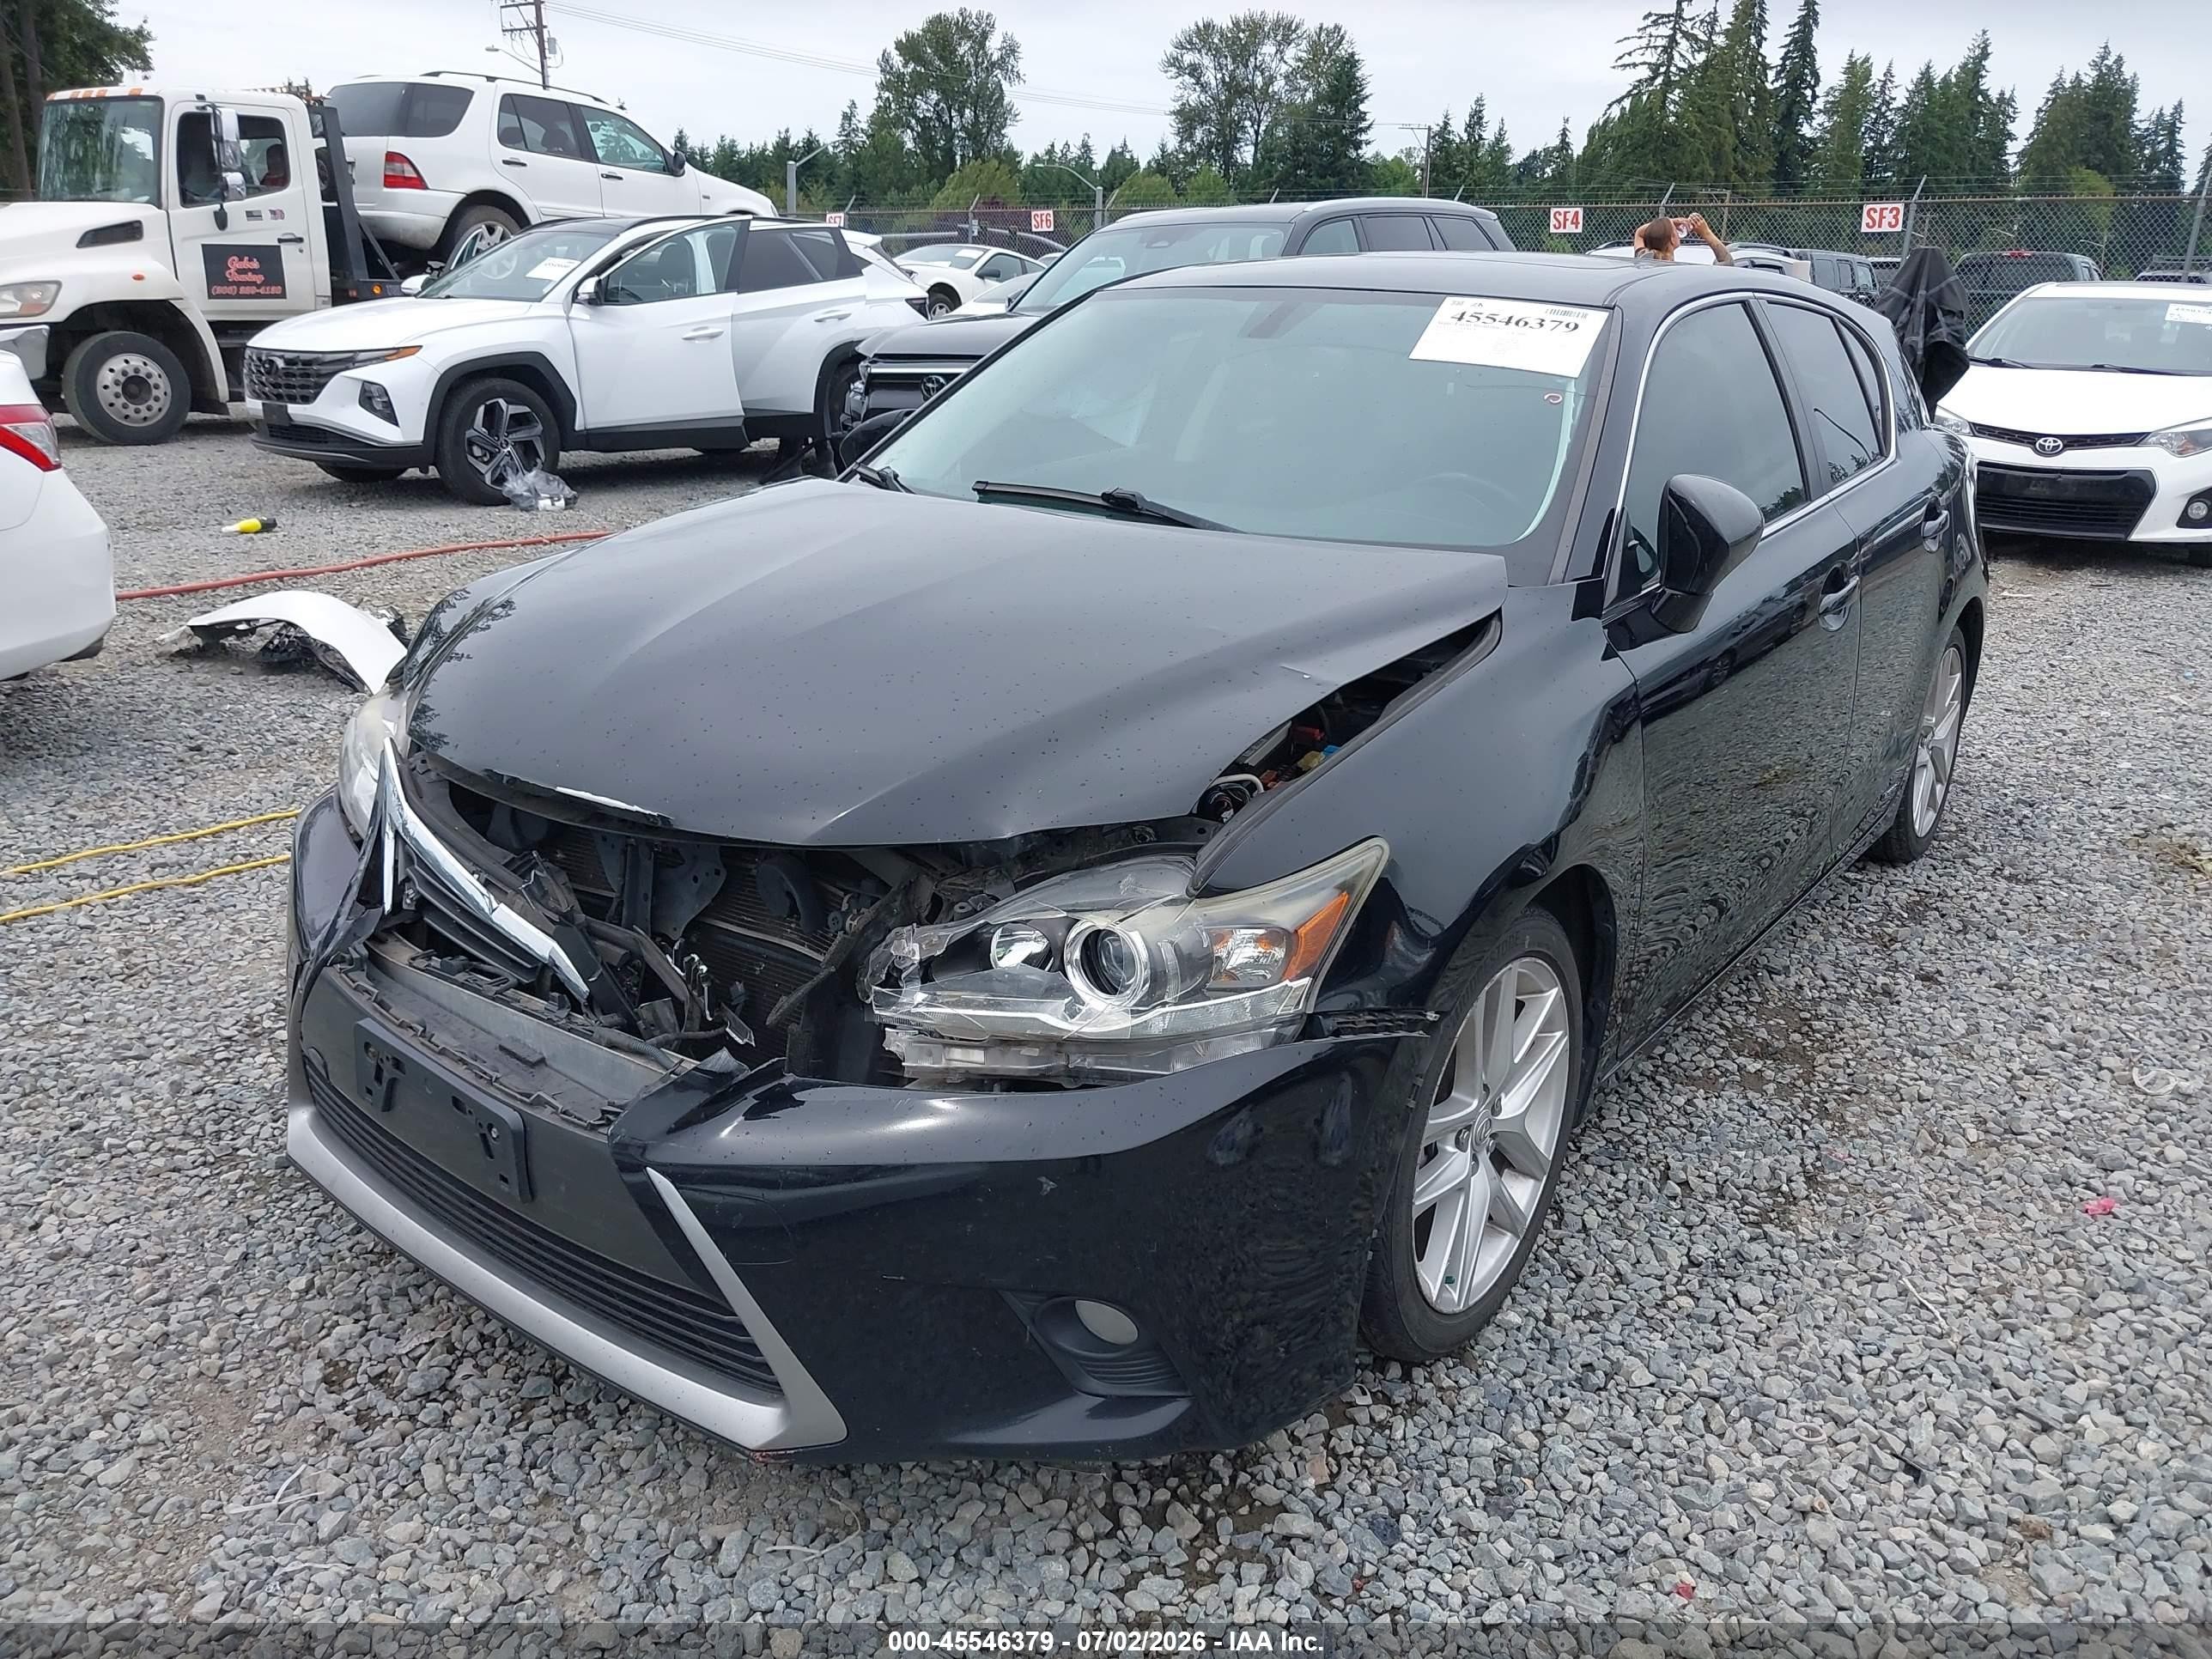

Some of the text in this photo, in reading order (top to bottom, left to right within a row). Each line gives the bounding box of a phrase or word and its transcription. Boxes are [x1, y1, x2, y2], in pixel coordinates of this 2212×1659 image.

[1033, 212, 1052, 229] SF6
[1553, 210, 1581, 230] SF4
[1865, 206, 1900, 229] SF3
[1450, 310, 1580, 333] 45546379
